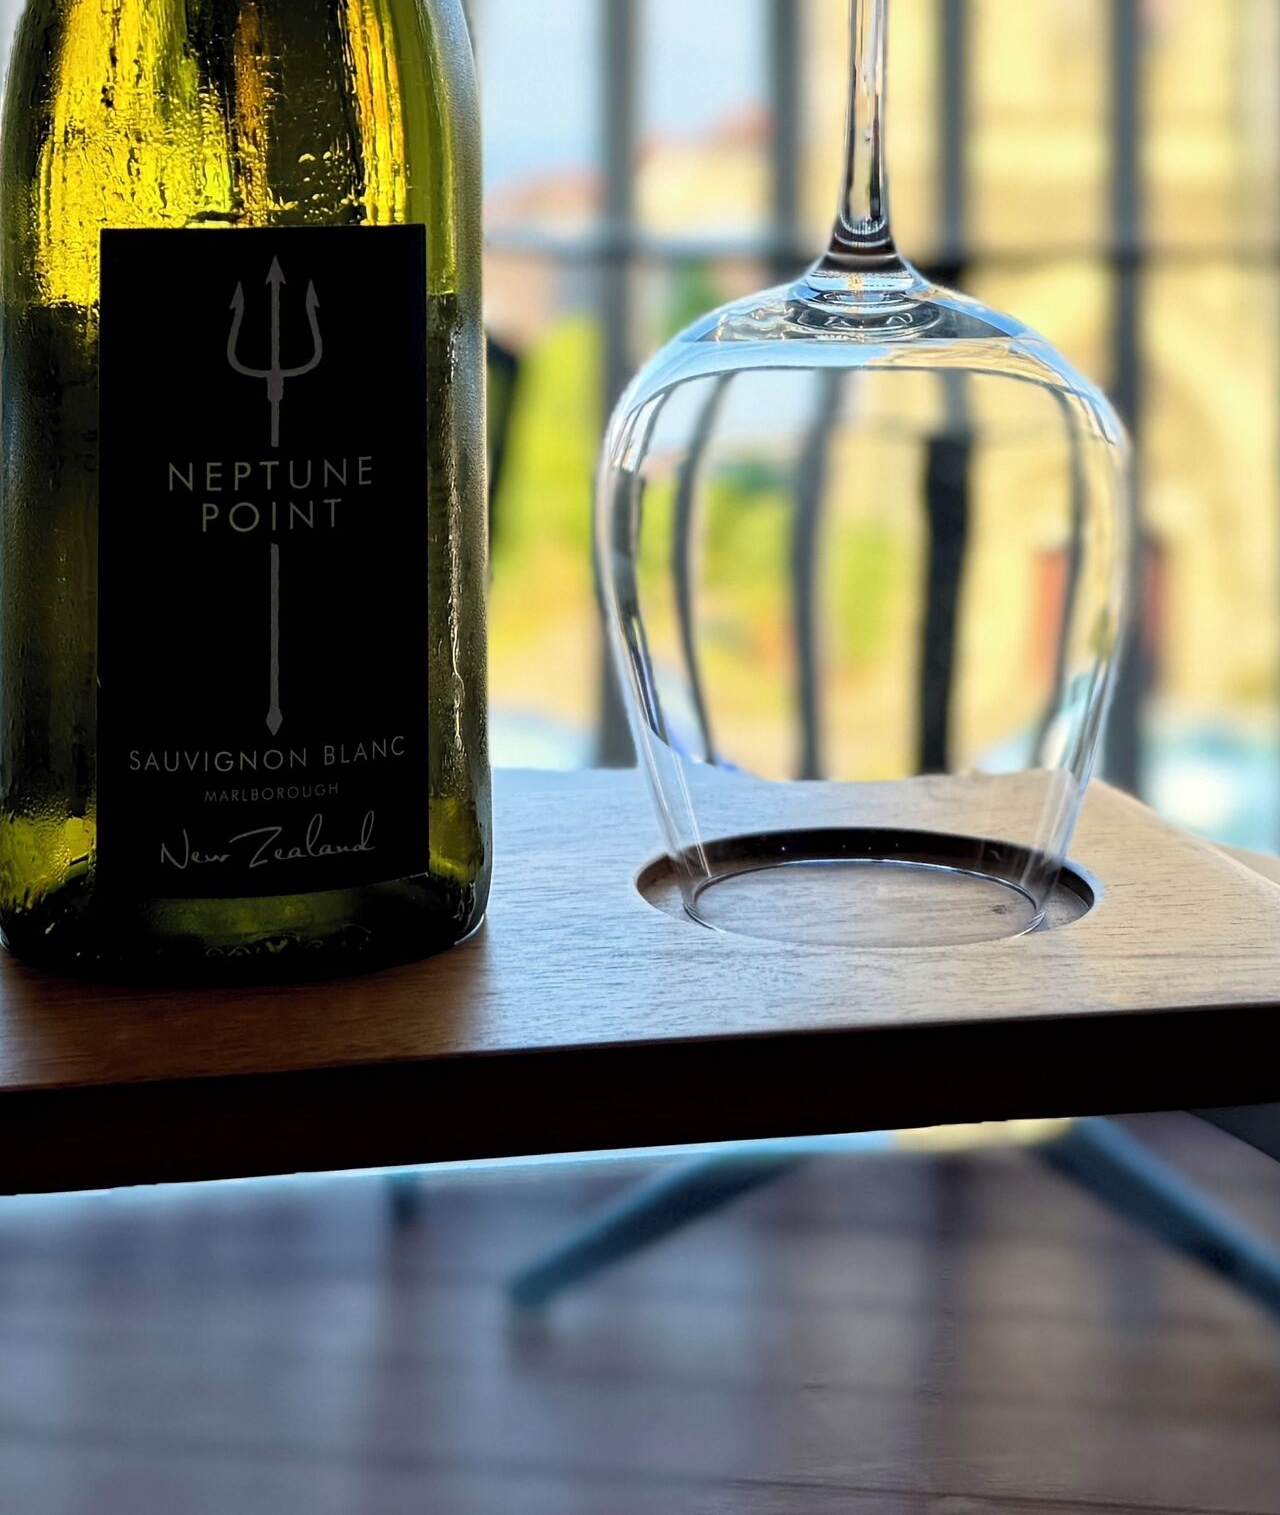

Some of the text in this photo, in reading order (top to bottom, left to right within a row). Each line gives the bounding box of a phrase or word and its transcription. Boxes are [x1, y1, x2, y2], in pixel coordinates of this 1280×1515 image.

[168, 456, 373, 492] NEPTUNE
[202, 498, 342, 533] POINT
[129, 735, 405, 772] SAUVIGNON BLANC
[204, 783, 339, 802] MARLBOROUGH
[160, 810, 376, 870] New Zealand
